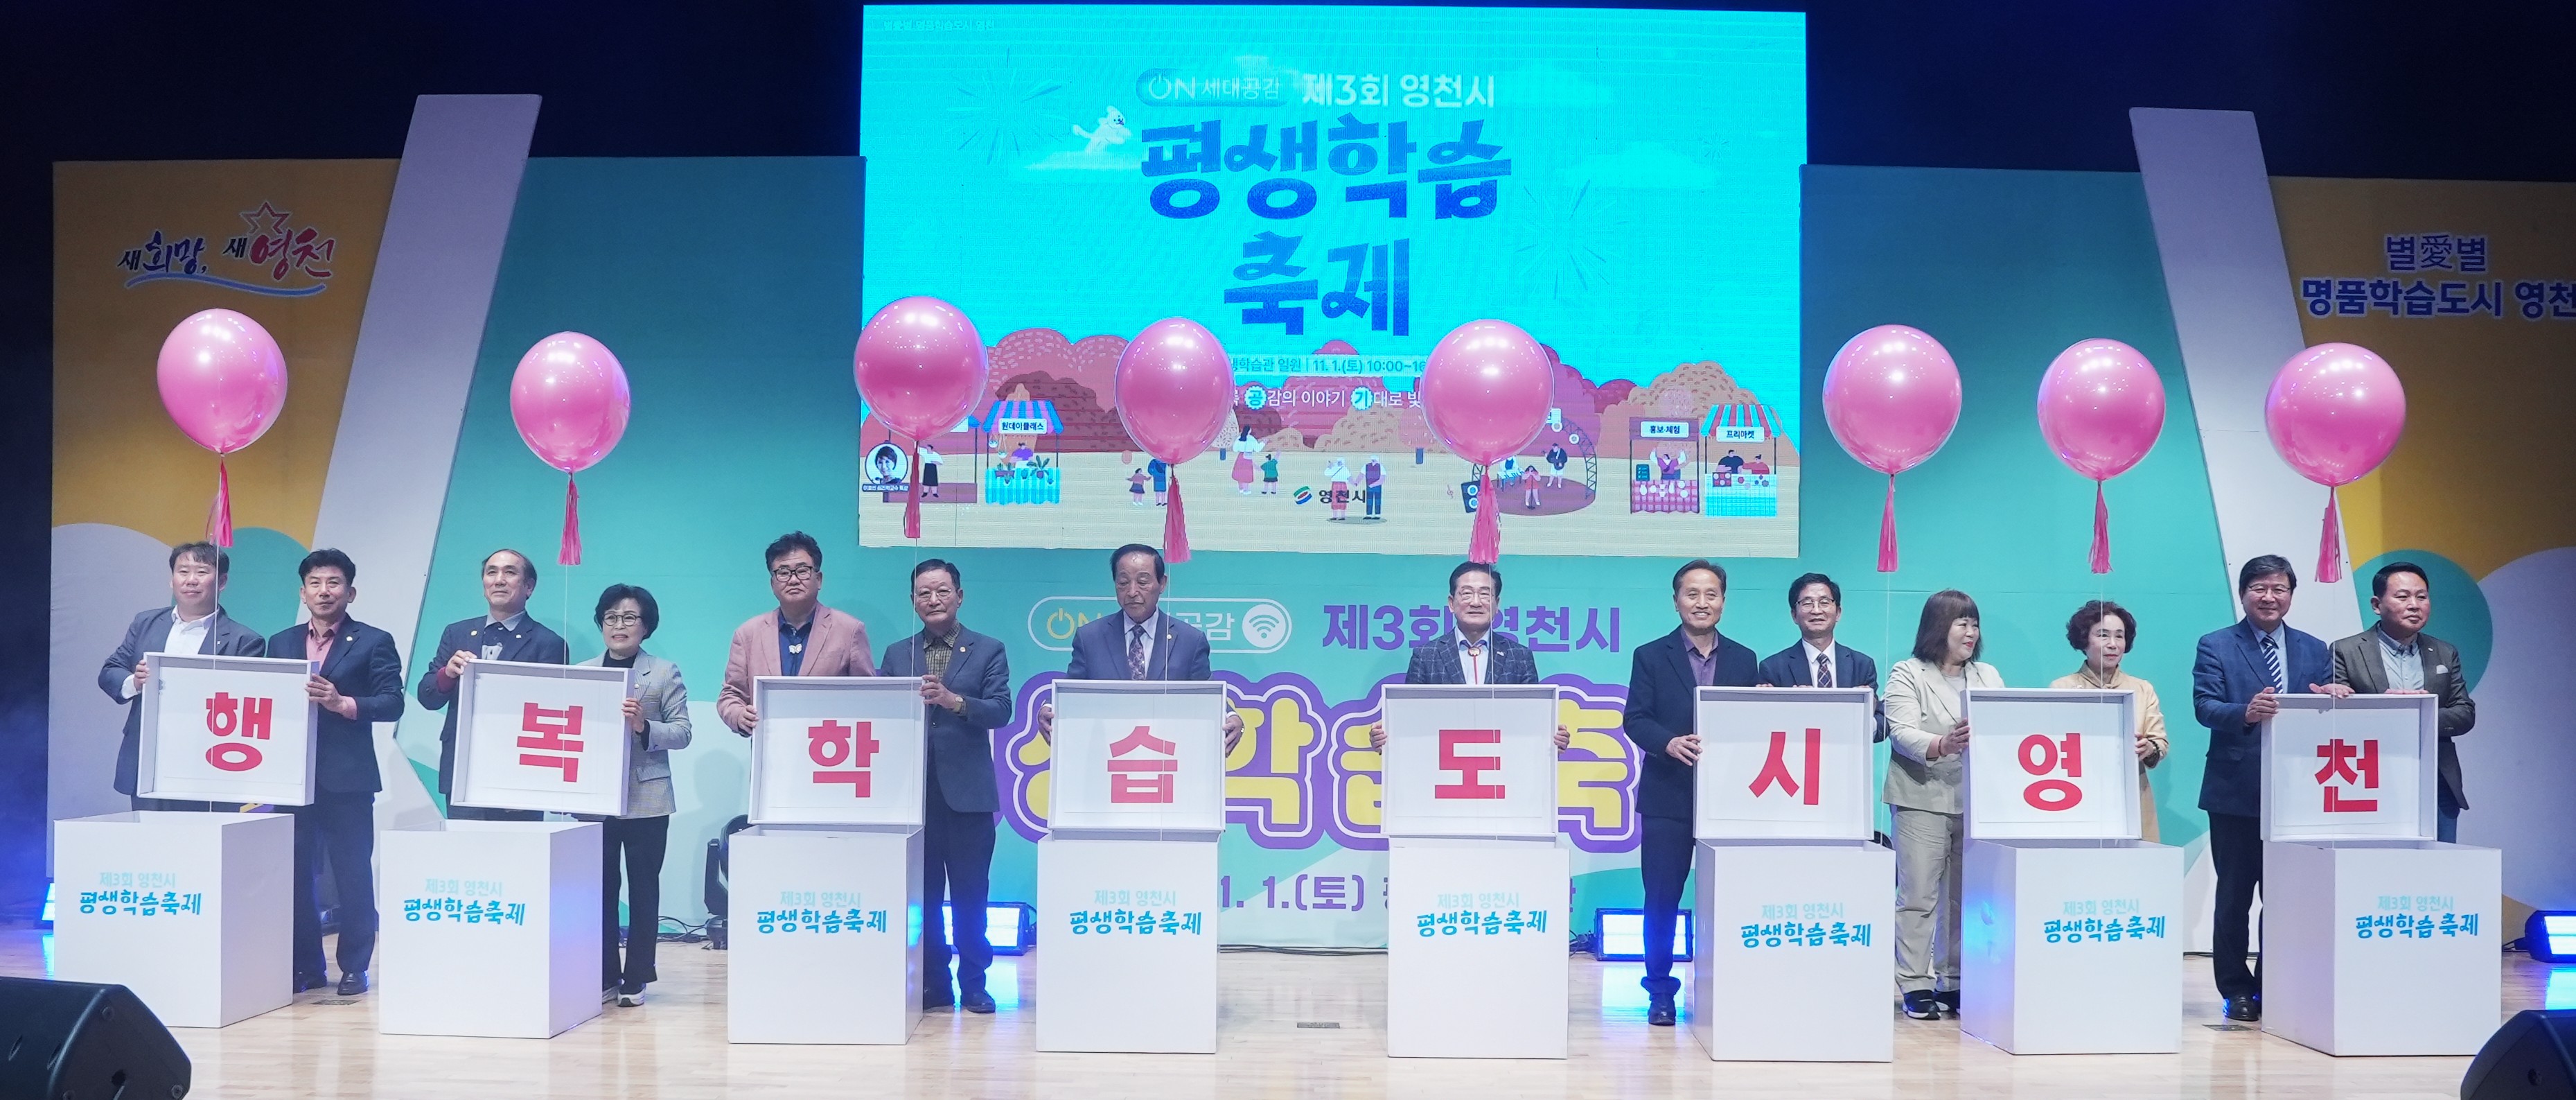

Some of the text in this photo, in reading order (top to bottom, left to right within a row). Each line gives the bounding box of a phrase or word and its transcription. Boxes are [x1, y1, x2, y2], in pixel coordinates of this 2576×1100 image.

[1148, 73, 1494, 108] ON 세대공감 제3회 영천시
[1140, 112, 1512, 220] 평생학습
[2385, 234, 2487, 272] 별愛별
[1224, 230, 1410, 336] 축제
[2302, 279, 2576, 318] 명품학습도시 영천
[1278, 358, 1301, 372] 일원
[1248, 389, 1296, 408] 공감의
[1301, 390, 1346, 408] 이야기
[1355, 390, 1403, 408] 기대로
[1726, 430, 1755, 439] 프리마켓
[1318, 489, 1366, 504] 영천시
[205, 692, 273, 771] 행
[517, 702, 584, 783] 복
[808, 719, 880, 798] 학
[1106, 726, 1178, 803] 습
[1434, 729, 1506, 799] 도
[1748, 728, 1821, 805] 시
[2018, 733, 2083, 812] 영
[2314, 738, 2379, 812] 천
[99, 871, 176, 889] 제3회 영천시
[425, 878, 503, 896] 제3회 영천시
[79, 889, 202, 916] 평생학습축제
[403, 897, 526, 925] 평생학습축제
[780, 891, 861, 908] 제3회 영천시
[1094, 889, 1177, 907] 제3회 영천시
[1437, 891, 1520, 909] 제3회 영천시
[1761, 902, 1844, 920] 제3회 영천시
[2063, 898, 2140, 916] 제3회 영천시
[2377, 895, 2455, 912] 제3회 영천시
[757, 909, 888, 934] 평생학습축제
[1070, 909, 1202, 936] 평생학습축제
[1416, 909, 1548, 938] 평생학습축제
[1740, 921, 1871, 948] 평생학습축제
[2043, 916, 2166, 943] 평생학습축제
[2356, 913, 2478, 939] 평생학습축제
